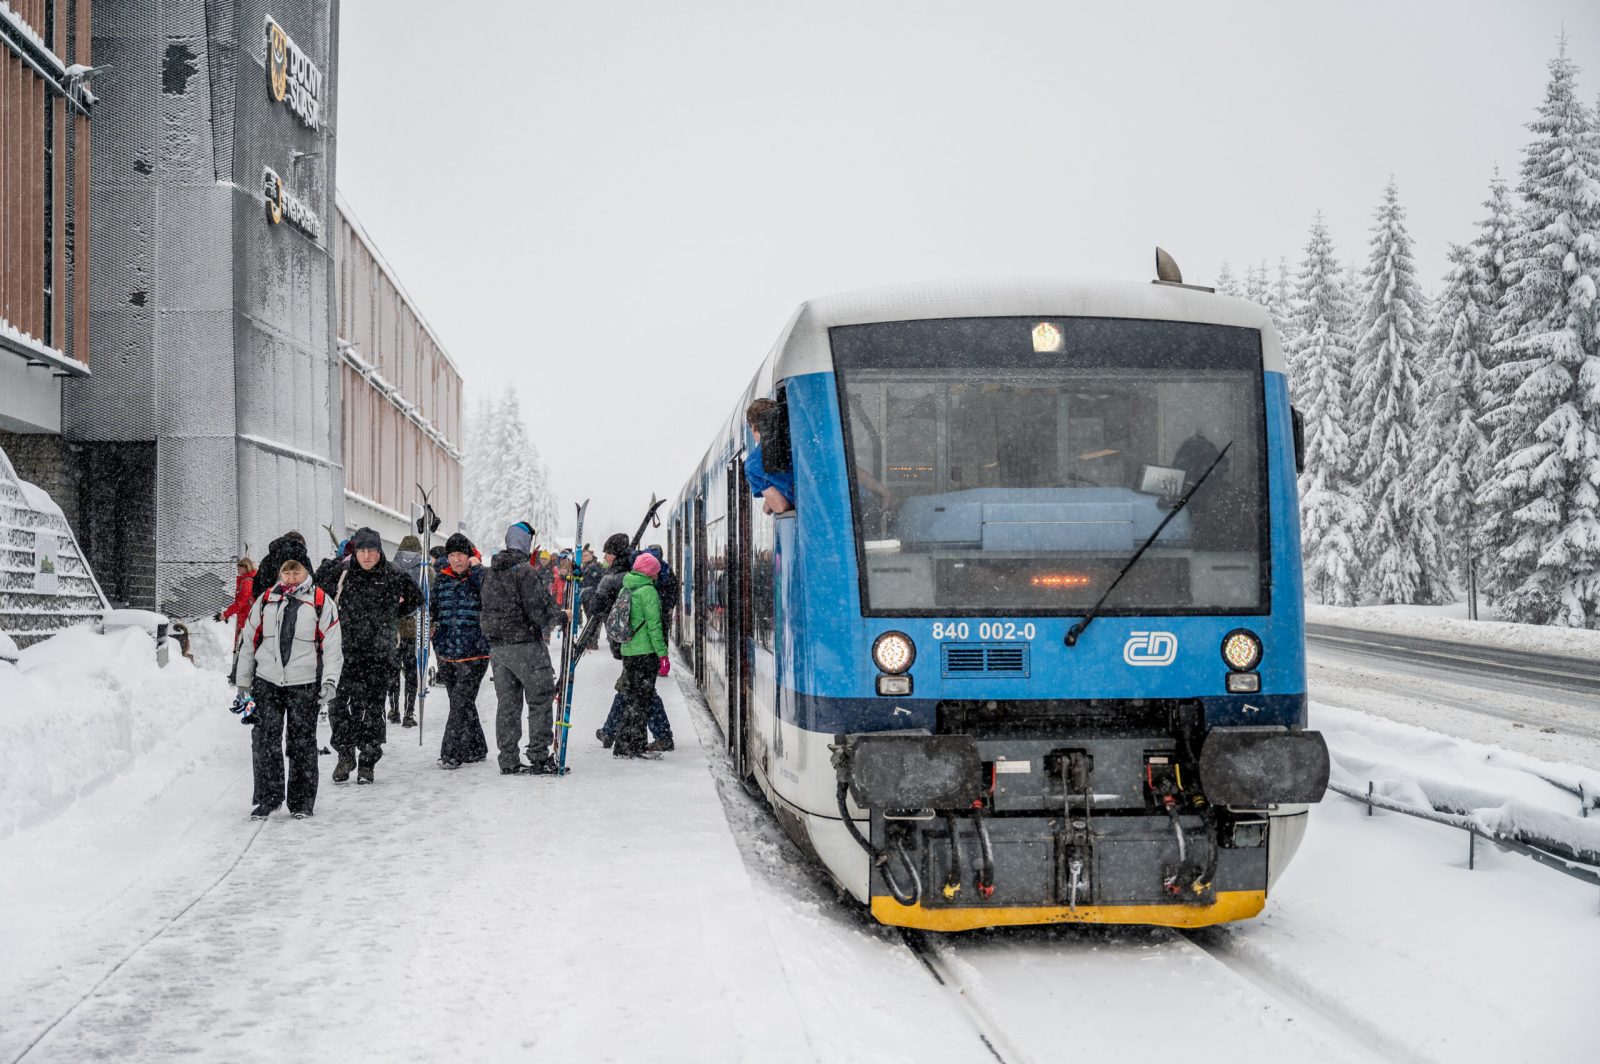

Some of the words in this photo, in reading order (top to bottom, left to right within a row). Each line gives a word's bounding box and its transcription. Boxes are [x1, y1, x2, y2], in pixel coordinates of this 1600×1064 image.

[290, 45, 322, 100] DOLNY
[932, 622, 969, 640] 840
[979, 622, 1036, 640] 002-0
